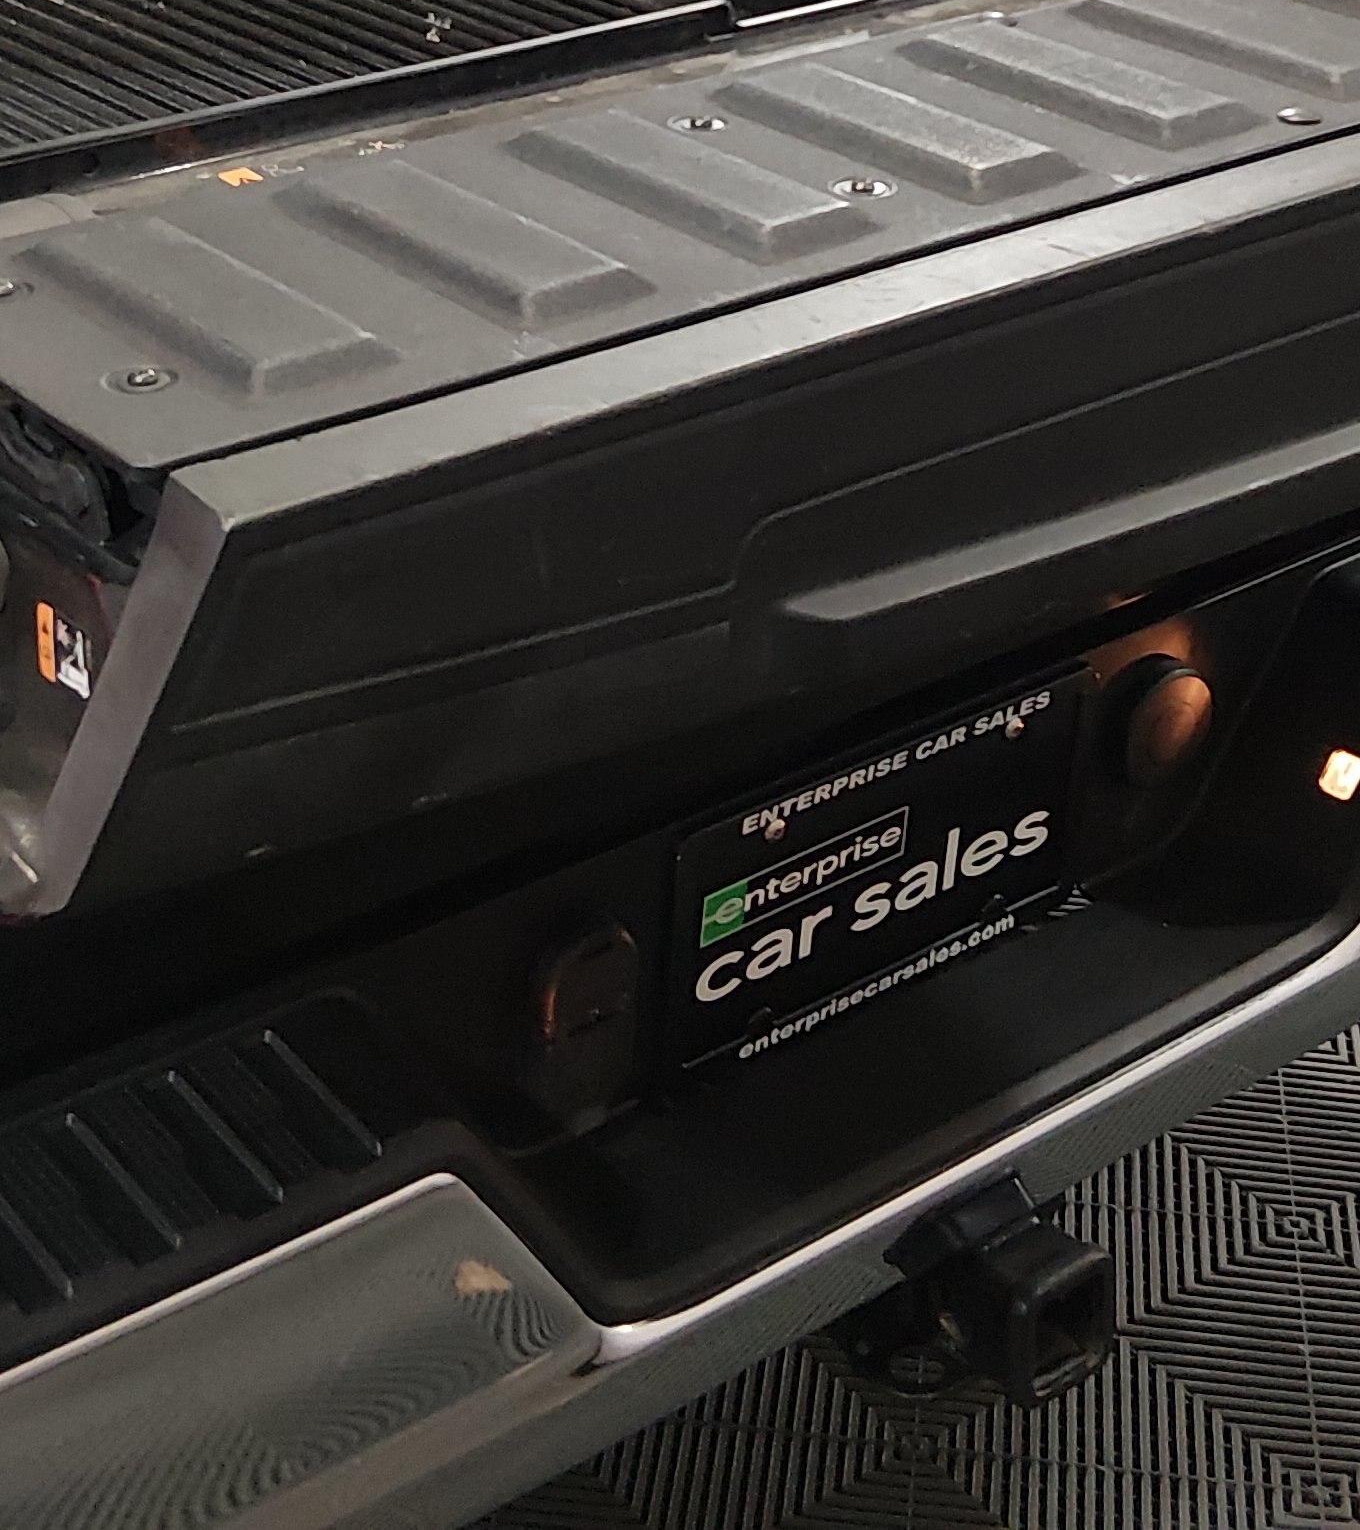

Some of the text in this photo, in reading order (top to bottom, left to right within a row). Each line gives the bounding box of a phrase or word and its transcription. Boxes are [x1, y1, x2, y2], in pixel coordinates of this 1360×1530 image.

[742, 691, 1051, 836] ENTERPRISE CAR SALES
[695, 811, 1050, 1002] car sales
[714, 824, 902, 925] enterprise
[739, 913, 1015, 1059] enterprisecarsales.com
